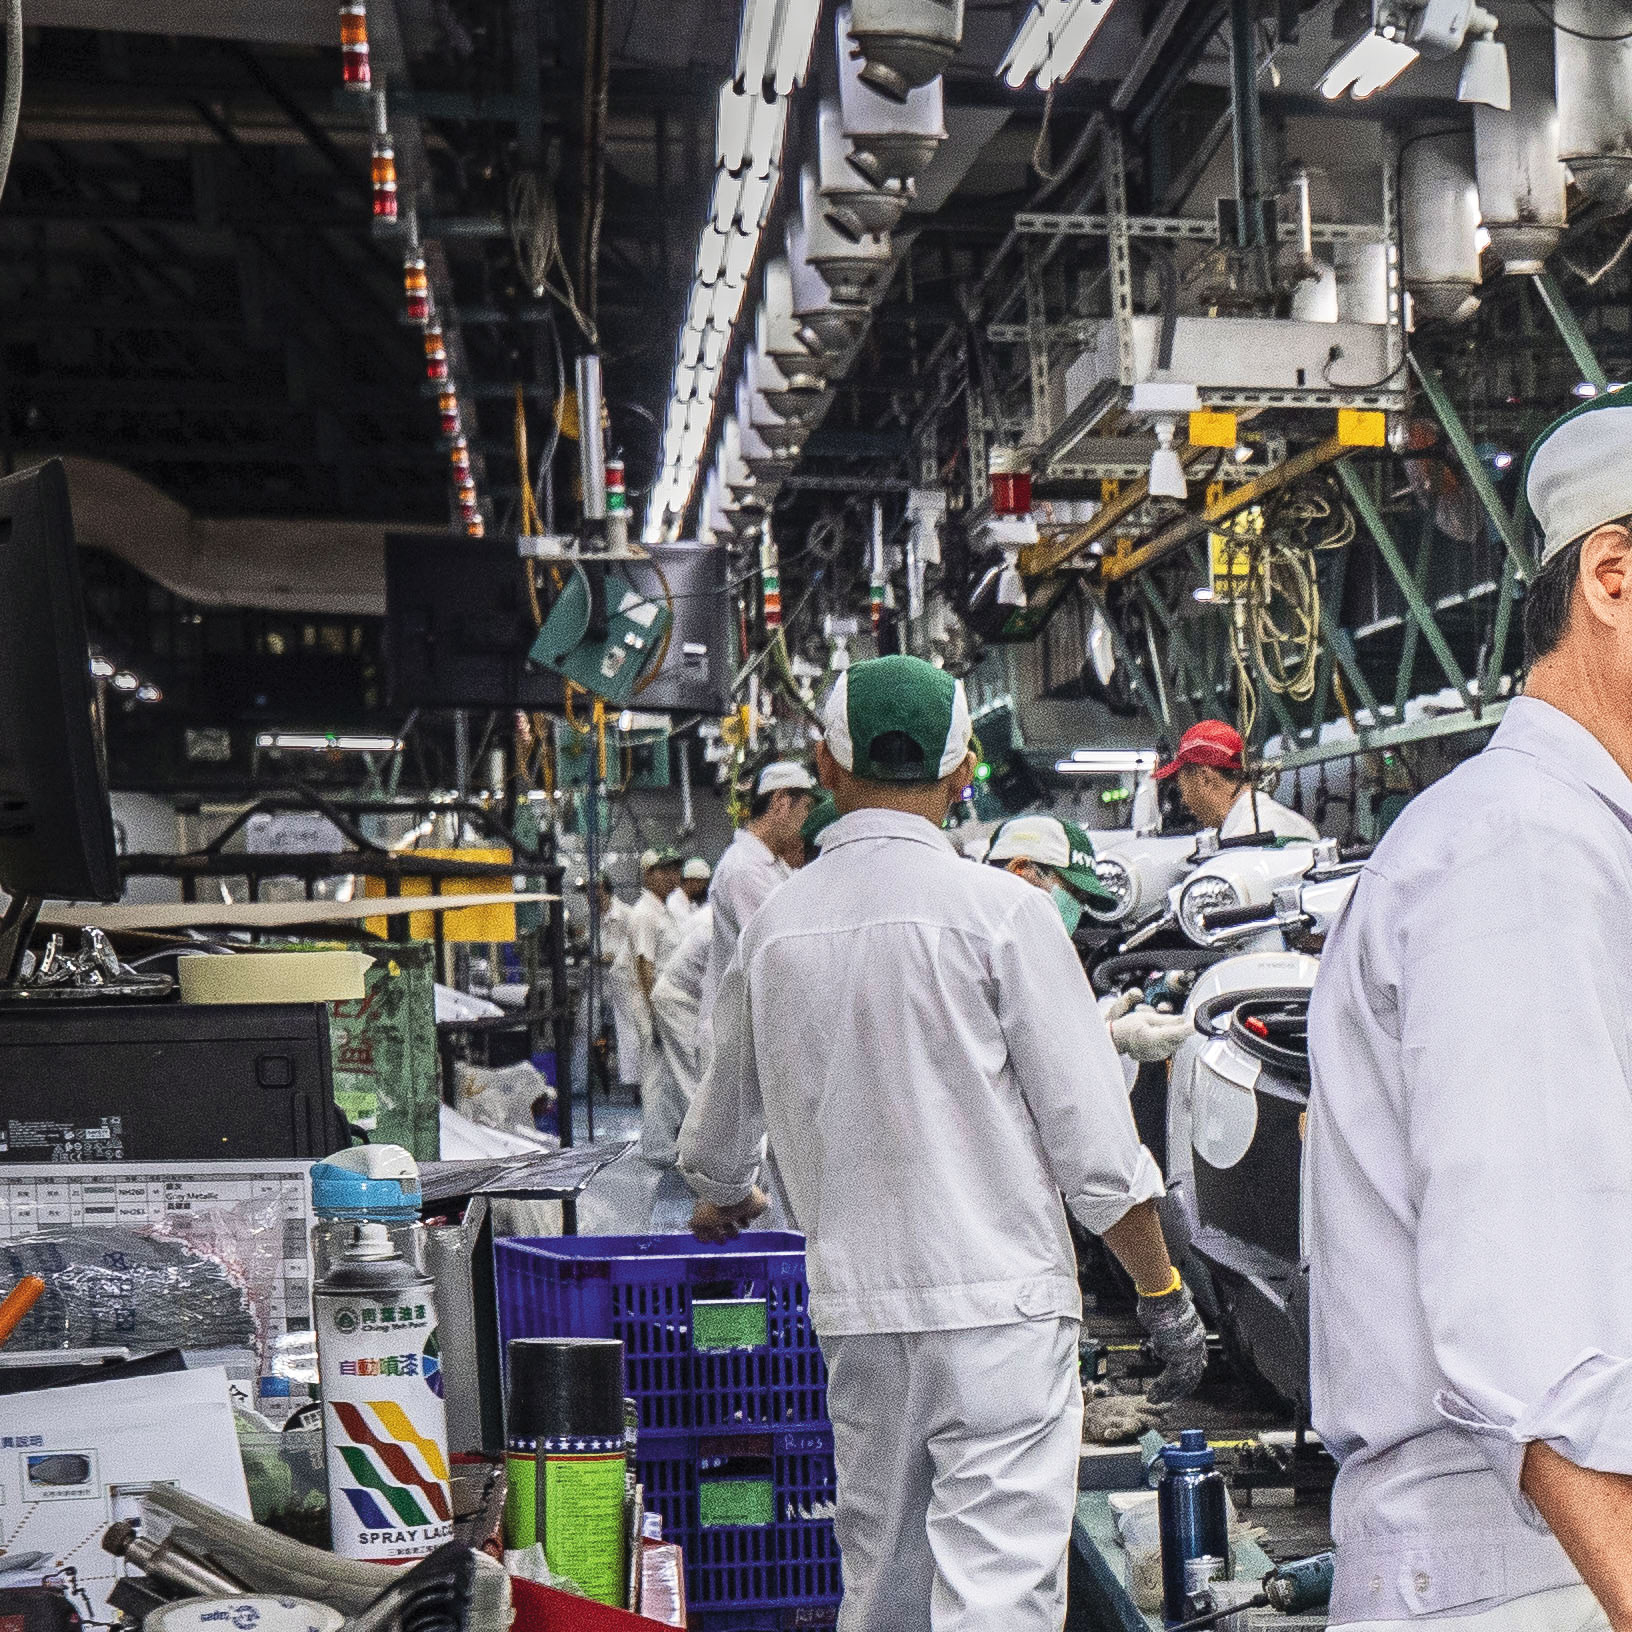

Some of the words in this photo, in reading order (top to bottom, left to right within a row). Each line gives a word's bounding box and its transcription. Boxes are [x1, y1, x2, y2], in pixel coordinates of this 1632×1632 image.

[339, 1352, 419, 1378] 自動噴漆
[359, 1529, 418, 1545] SPRAY
